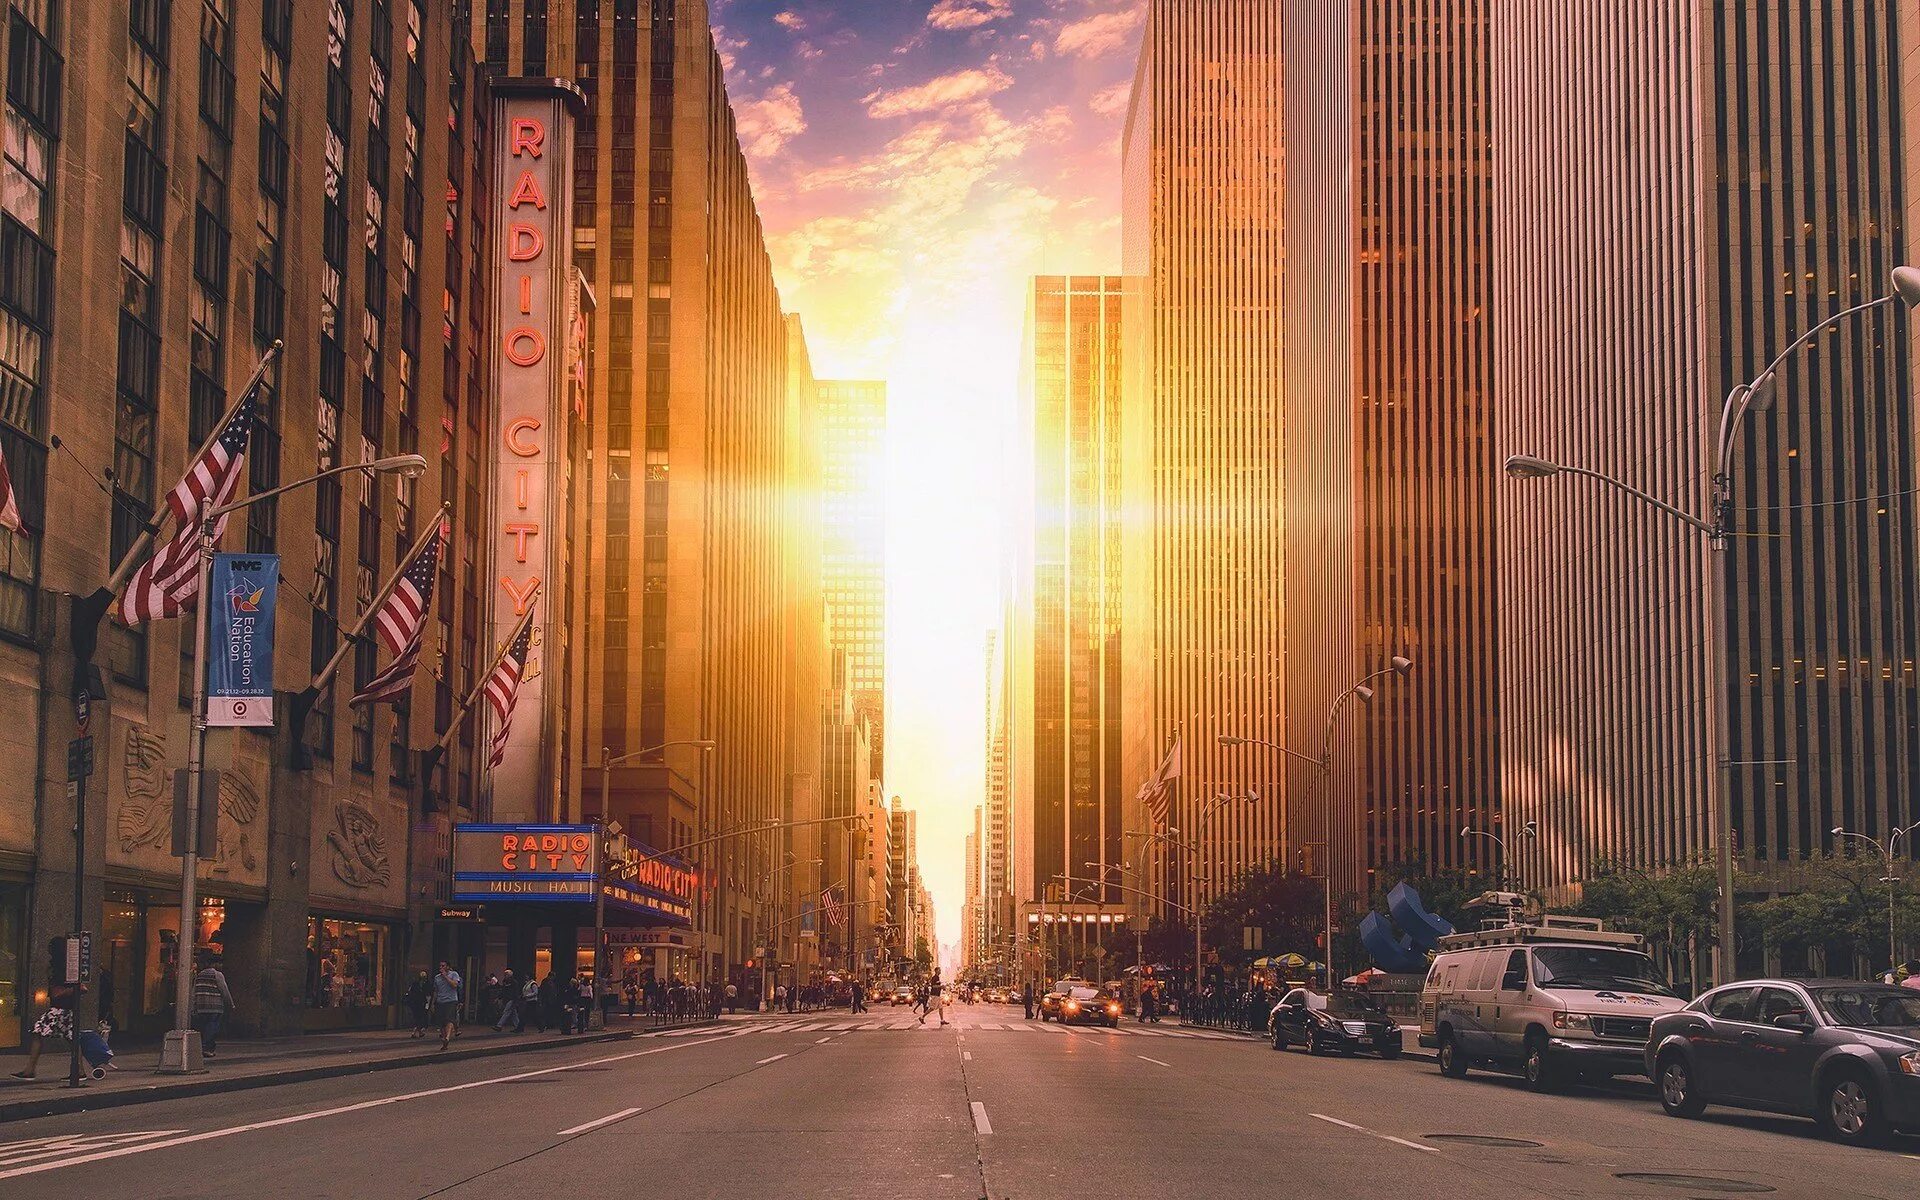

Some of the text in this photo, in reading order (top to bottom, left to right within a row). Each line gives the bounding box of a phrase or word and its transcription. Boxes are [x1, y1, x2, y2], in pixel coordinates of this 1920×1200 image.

[504, 117, 546, 366] RADIO
[500, 416, 541, 615] CITY
[231, 561, 262, 571] NYC
[231, 617, 241, 662] Nation
[242, 617, 255, 685] Education
[503, 834, 590, 852] RADIO
[502, 853, 588, 871] CITY
[640, 854, 672, 892] RADIO
[490, 881, 537, 892] MUSIC
[441, 909, 471, 918] Subway
[631, 934, 661, 944] WEST
